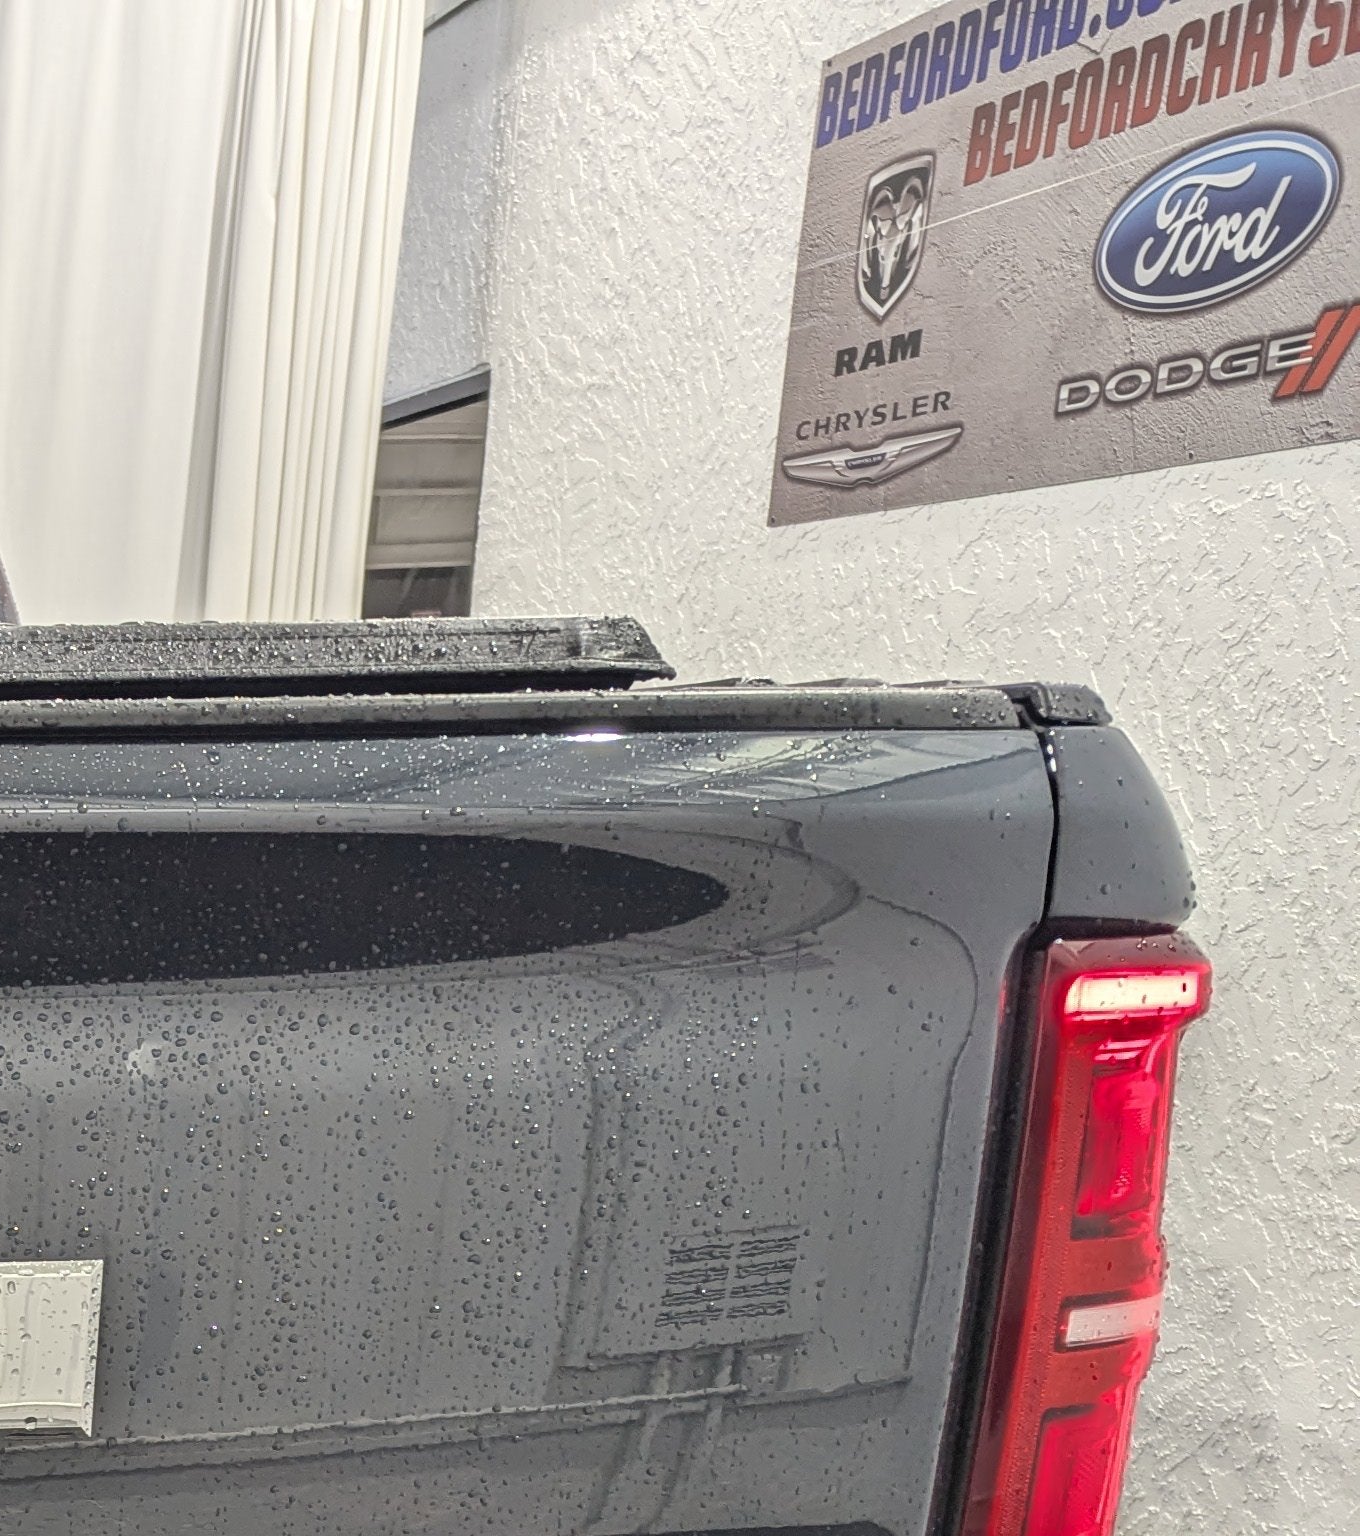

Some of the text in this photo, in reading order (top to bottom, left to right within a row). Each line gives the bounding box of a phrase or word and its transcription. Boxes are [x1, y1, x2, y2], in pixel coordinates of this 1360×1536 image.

[1134, 161, 1293, 288] Ford
[834, 328, 923, 377] RAM
[1056, 330, 1318, 416] DODGE
[795, 390, 951, 440] CHRYSLER
